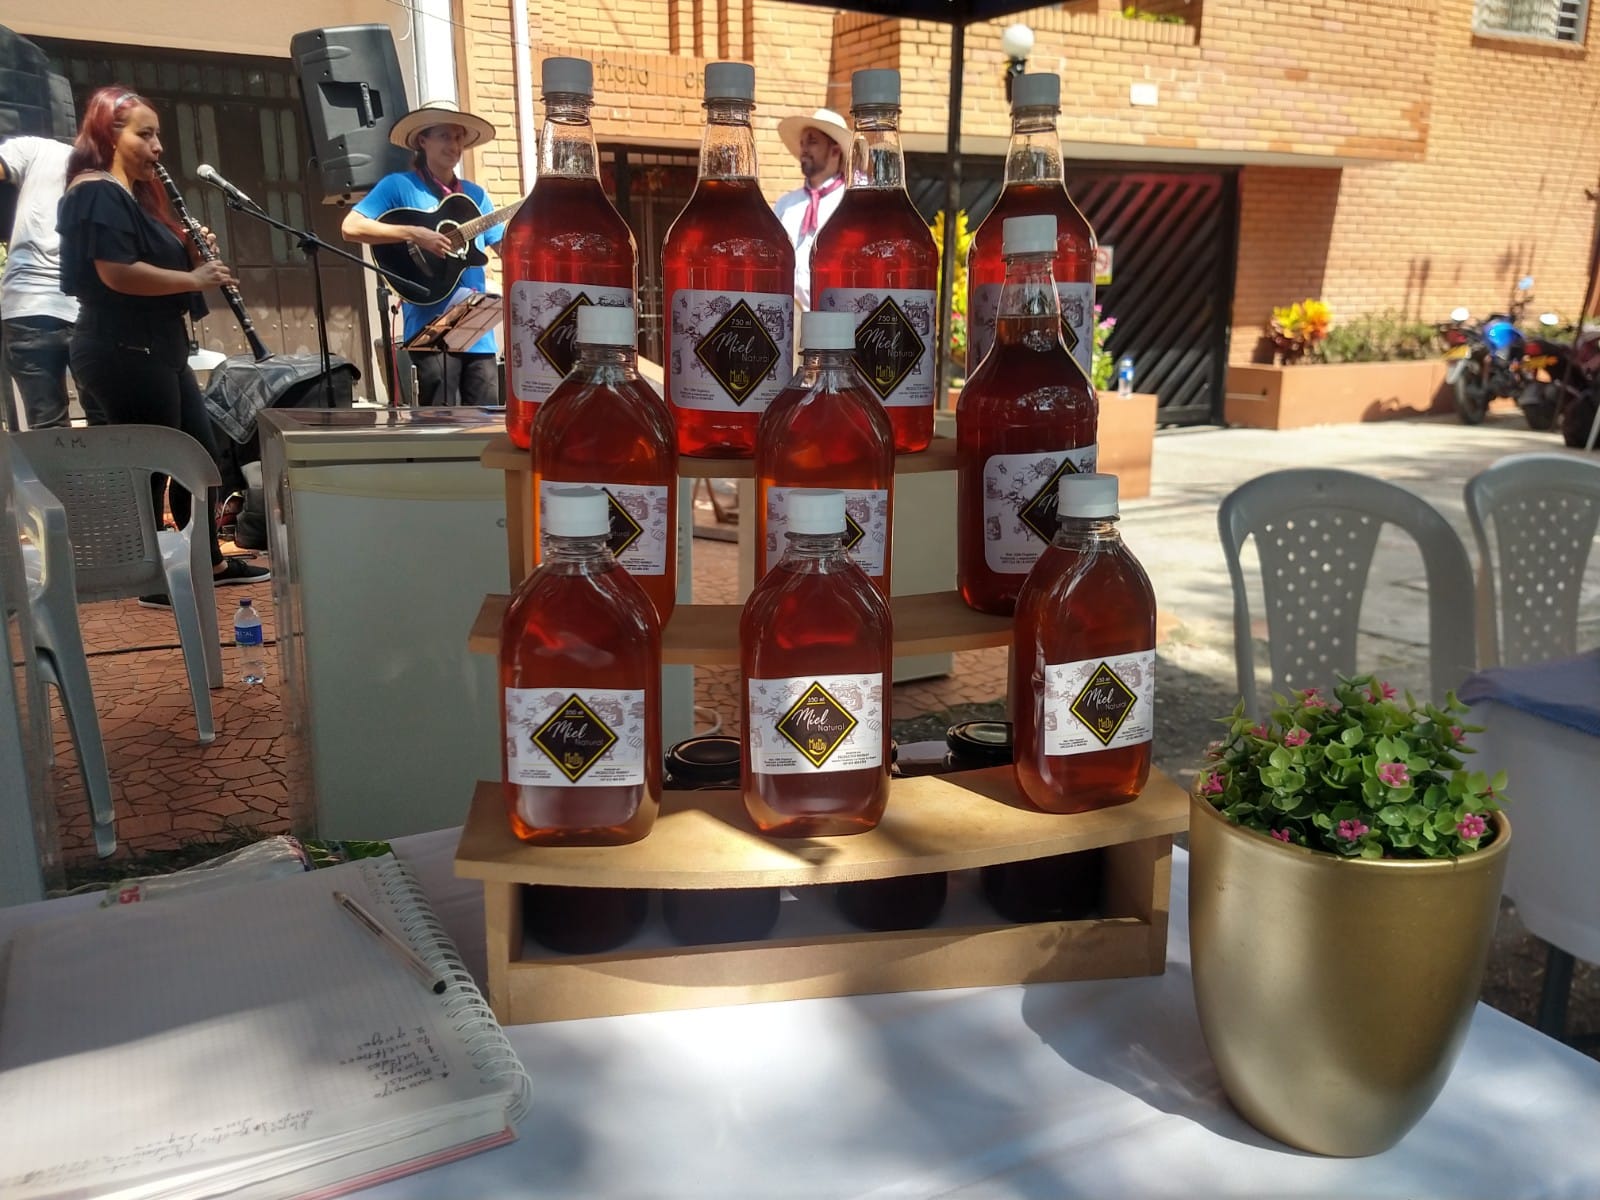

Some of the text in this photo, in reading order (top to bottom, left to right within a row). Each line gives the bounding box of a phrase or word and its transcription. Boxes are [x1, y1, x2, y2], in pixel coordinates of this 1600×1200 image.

[731, 318, 745, 326] 750
[712, 331, 756, 360] Miel
[858, 327, 901, 355] Miel
[741, 352, 769, 363] Natural
[887, 350, 914, 358] Natural
[1082, 687, 1114, 710] Miel
[1105, 701, 1127, 710] Natural
[791, 707, 829, 731] Miel
[547, 720, 588, 744] Miel
[817, 722, 846, 732] Natural
[574, 738, 604, 747] Natural
